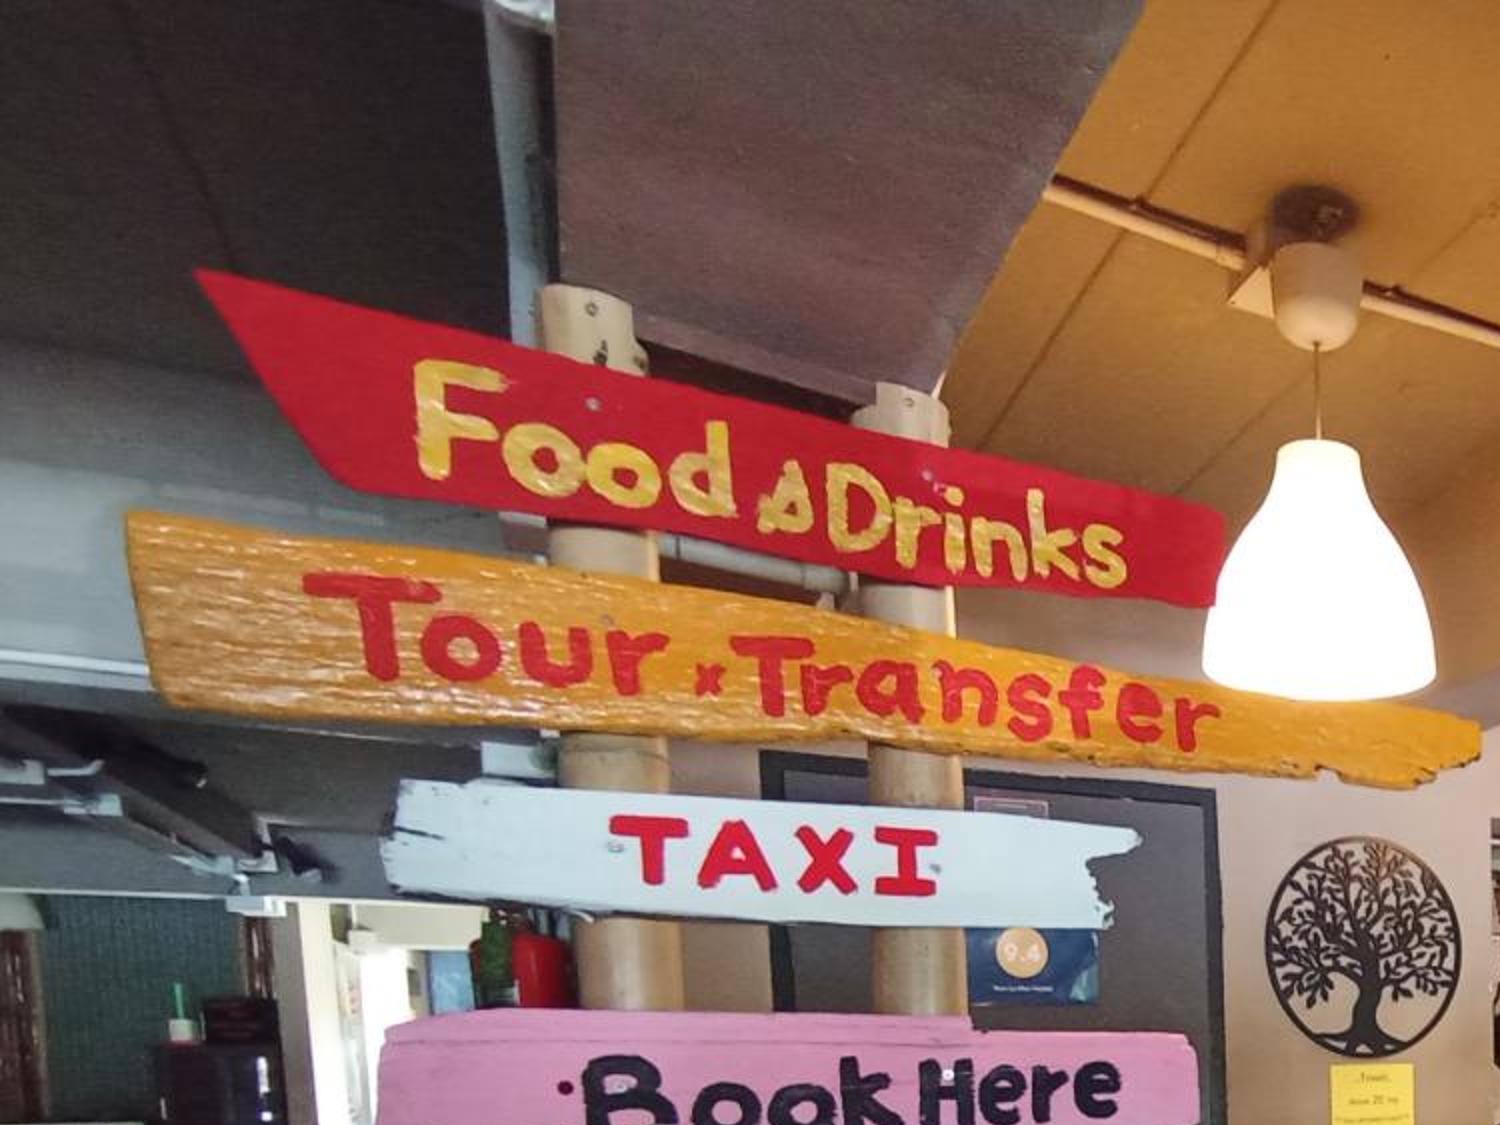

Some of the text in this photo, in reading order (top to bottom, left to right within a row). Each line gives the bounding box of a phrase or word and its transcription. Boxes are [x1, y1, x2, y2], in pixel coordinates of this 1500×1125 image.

[413, 358, 738, 519] Food
[826, 461, 1128, 590] Drinks
[302, 568, 669, 698] Tour
[730, 634, 1222, 753] Transfer
[609, 814, 940, 897] TAXI
